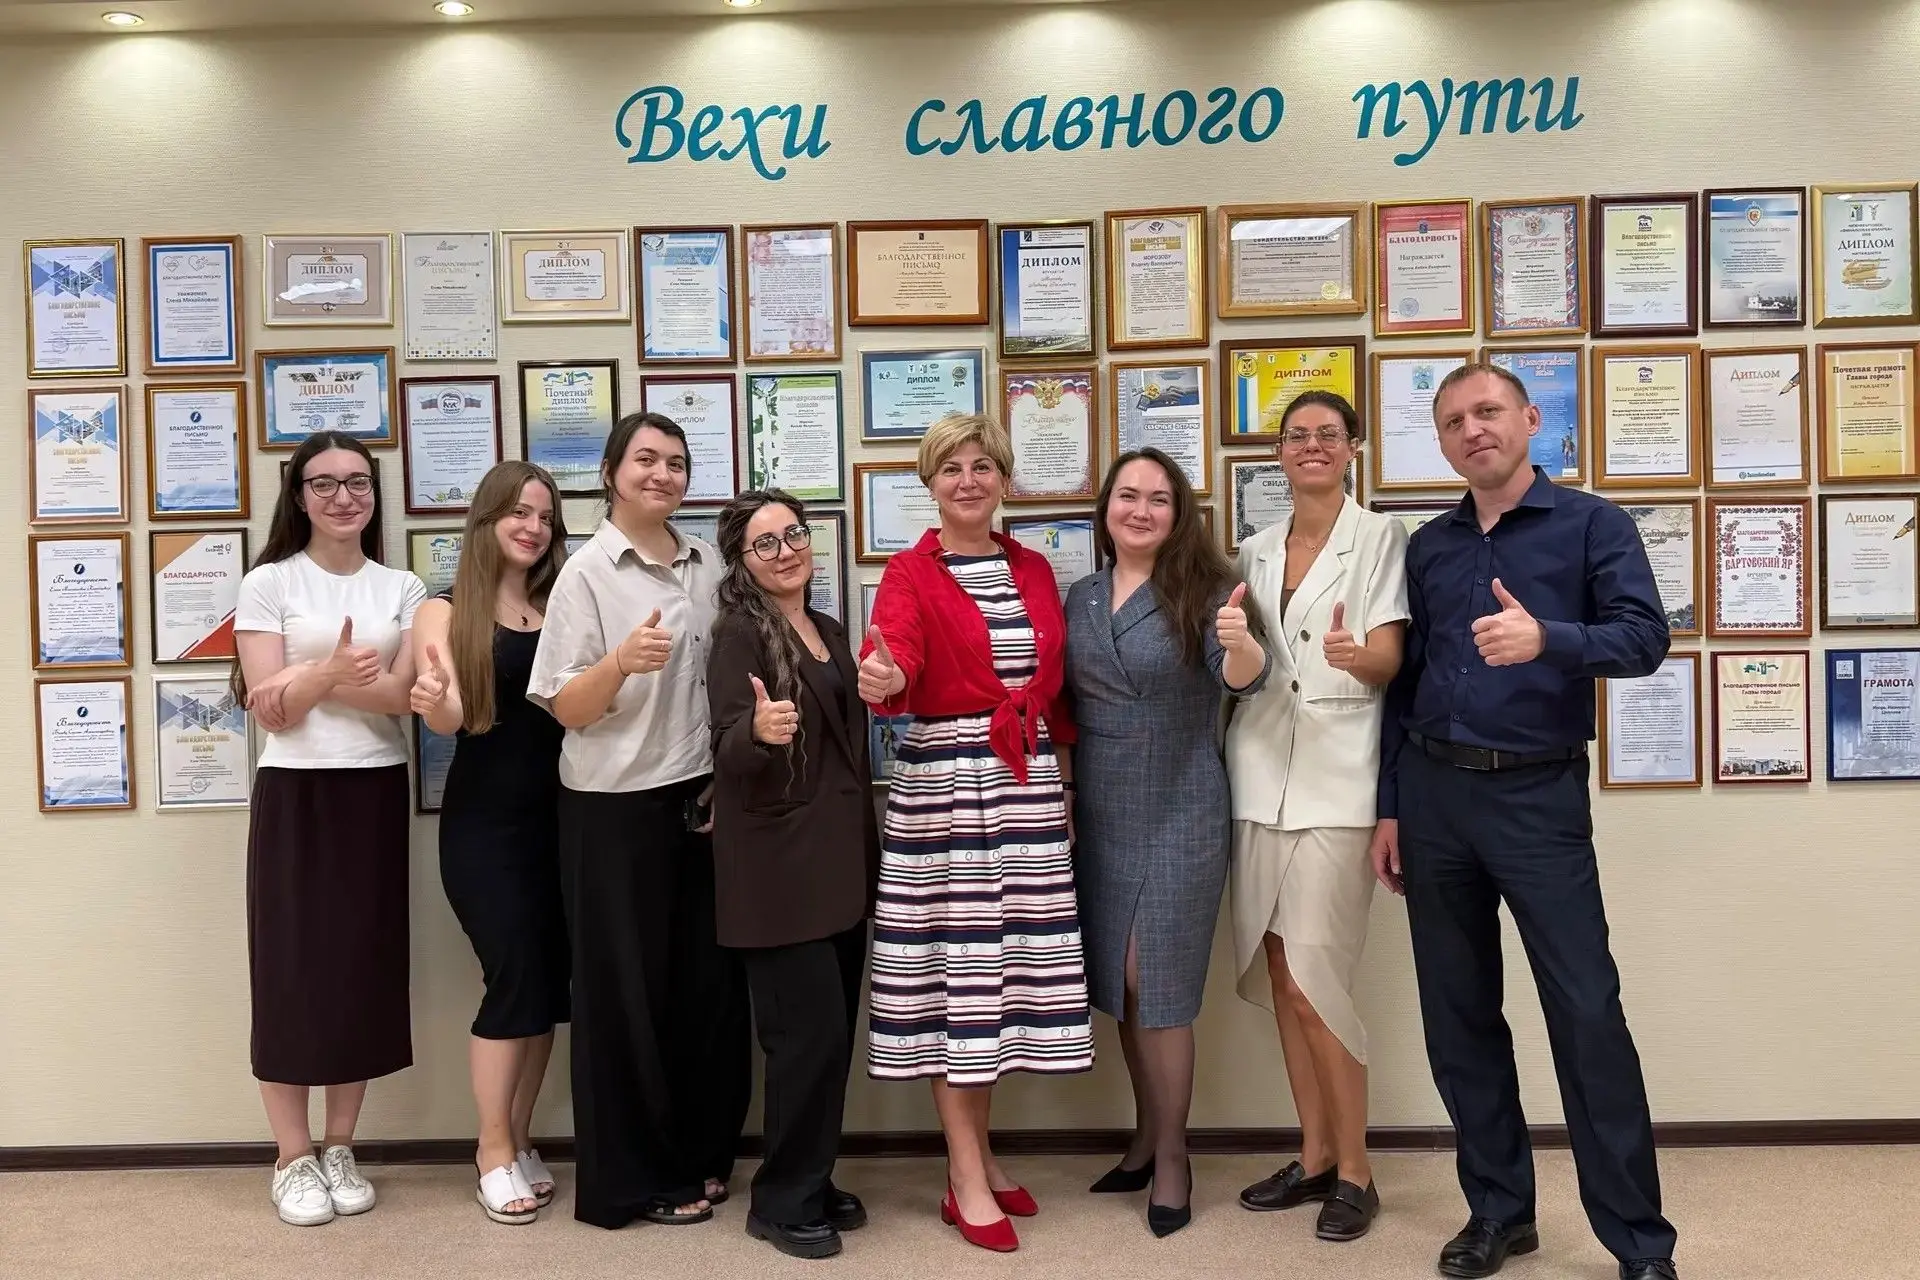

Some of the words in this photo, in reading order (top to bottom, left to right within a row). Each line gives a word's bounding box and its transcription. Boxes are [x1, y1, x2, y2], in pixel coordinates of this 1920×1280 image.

[615, 85, 831, 181] Вехи
[905, 86, 1285, 156] славного
[1351, 76, 1585, 167] пути
[1389, 235, 1458, 244] БЛАГОДАРНОСТЬ
[1838, 239, 1895, 251] ДИПЛОМ
[877, 252, 966, 261] БЛАГОДАРСТВЕННОЕ
[538, 258, 590, 268] ДИПЛОМ
[902, 260, 941, 270] ПИСЬМО
[1021, 256, 1081, 268] ДИПЛОМ
[301, 266, 353, 275] ДИПЛОМ
[1274, 368, 1332, 379] ДИПЛОМ
[1832, 366, 1871, 374] Почетная
[1874, 365, 1906, 373] грамота
[906, 376, 940, 385] ДИПЛОМ
[299, 385, 354, 396] ДИПЛОМ
[544, 388, 593, 398] Почетный
[551, 398, 587, 406] диплом
[1725, 556, 1780, 570] ВАРТОВСКИЙ
[1782, 558, 1793, 569] ЯР
[164, 572, 227, 580] БЛАГОДАРНОСТЬ
[1864, 678, 1914, 688] ГРАМОТА
